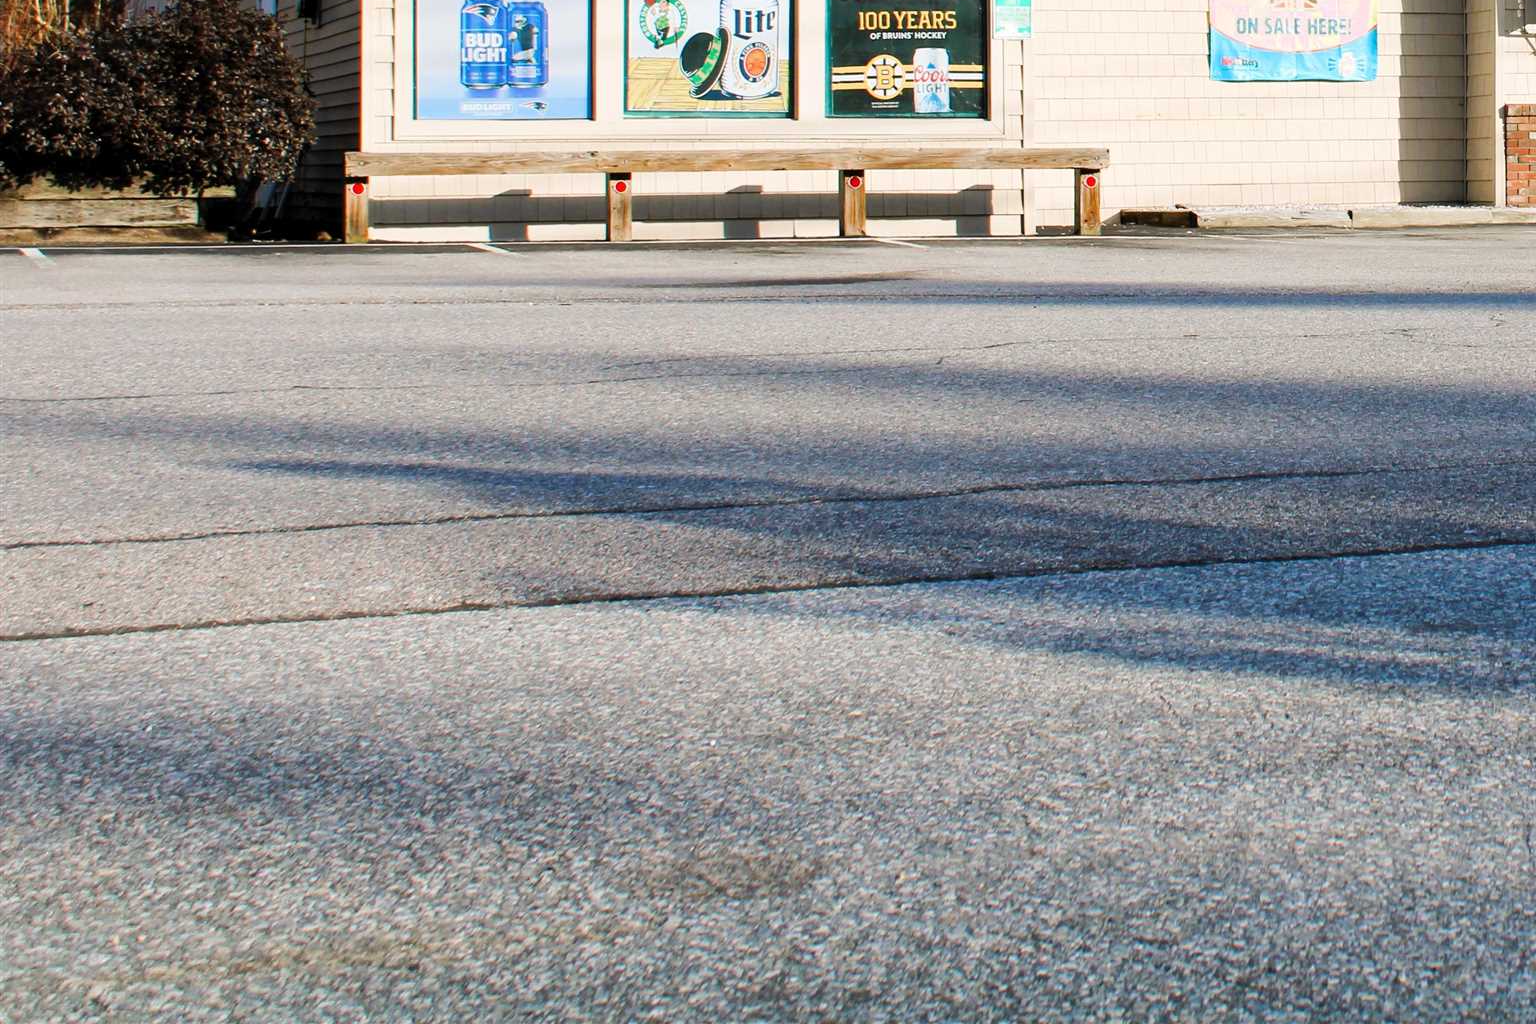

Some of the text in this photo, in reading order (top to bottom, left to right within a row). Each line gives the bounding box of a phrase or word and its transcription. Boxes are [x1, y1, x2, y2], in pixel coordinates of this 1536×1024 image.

[733, 8, 776, 40] Lite
[858, 10, 957, 30] 100 YEARS
[1236, 17, 1352, 36] ON SALE HERE!
[465, 33, 503, 48] BUD
[870, 31, 881, 40] OF
[914, 31, 947, 40] HOCKEY
[461, 47, 506, 63] LIGHT
[876, 64, 895, 89] B
